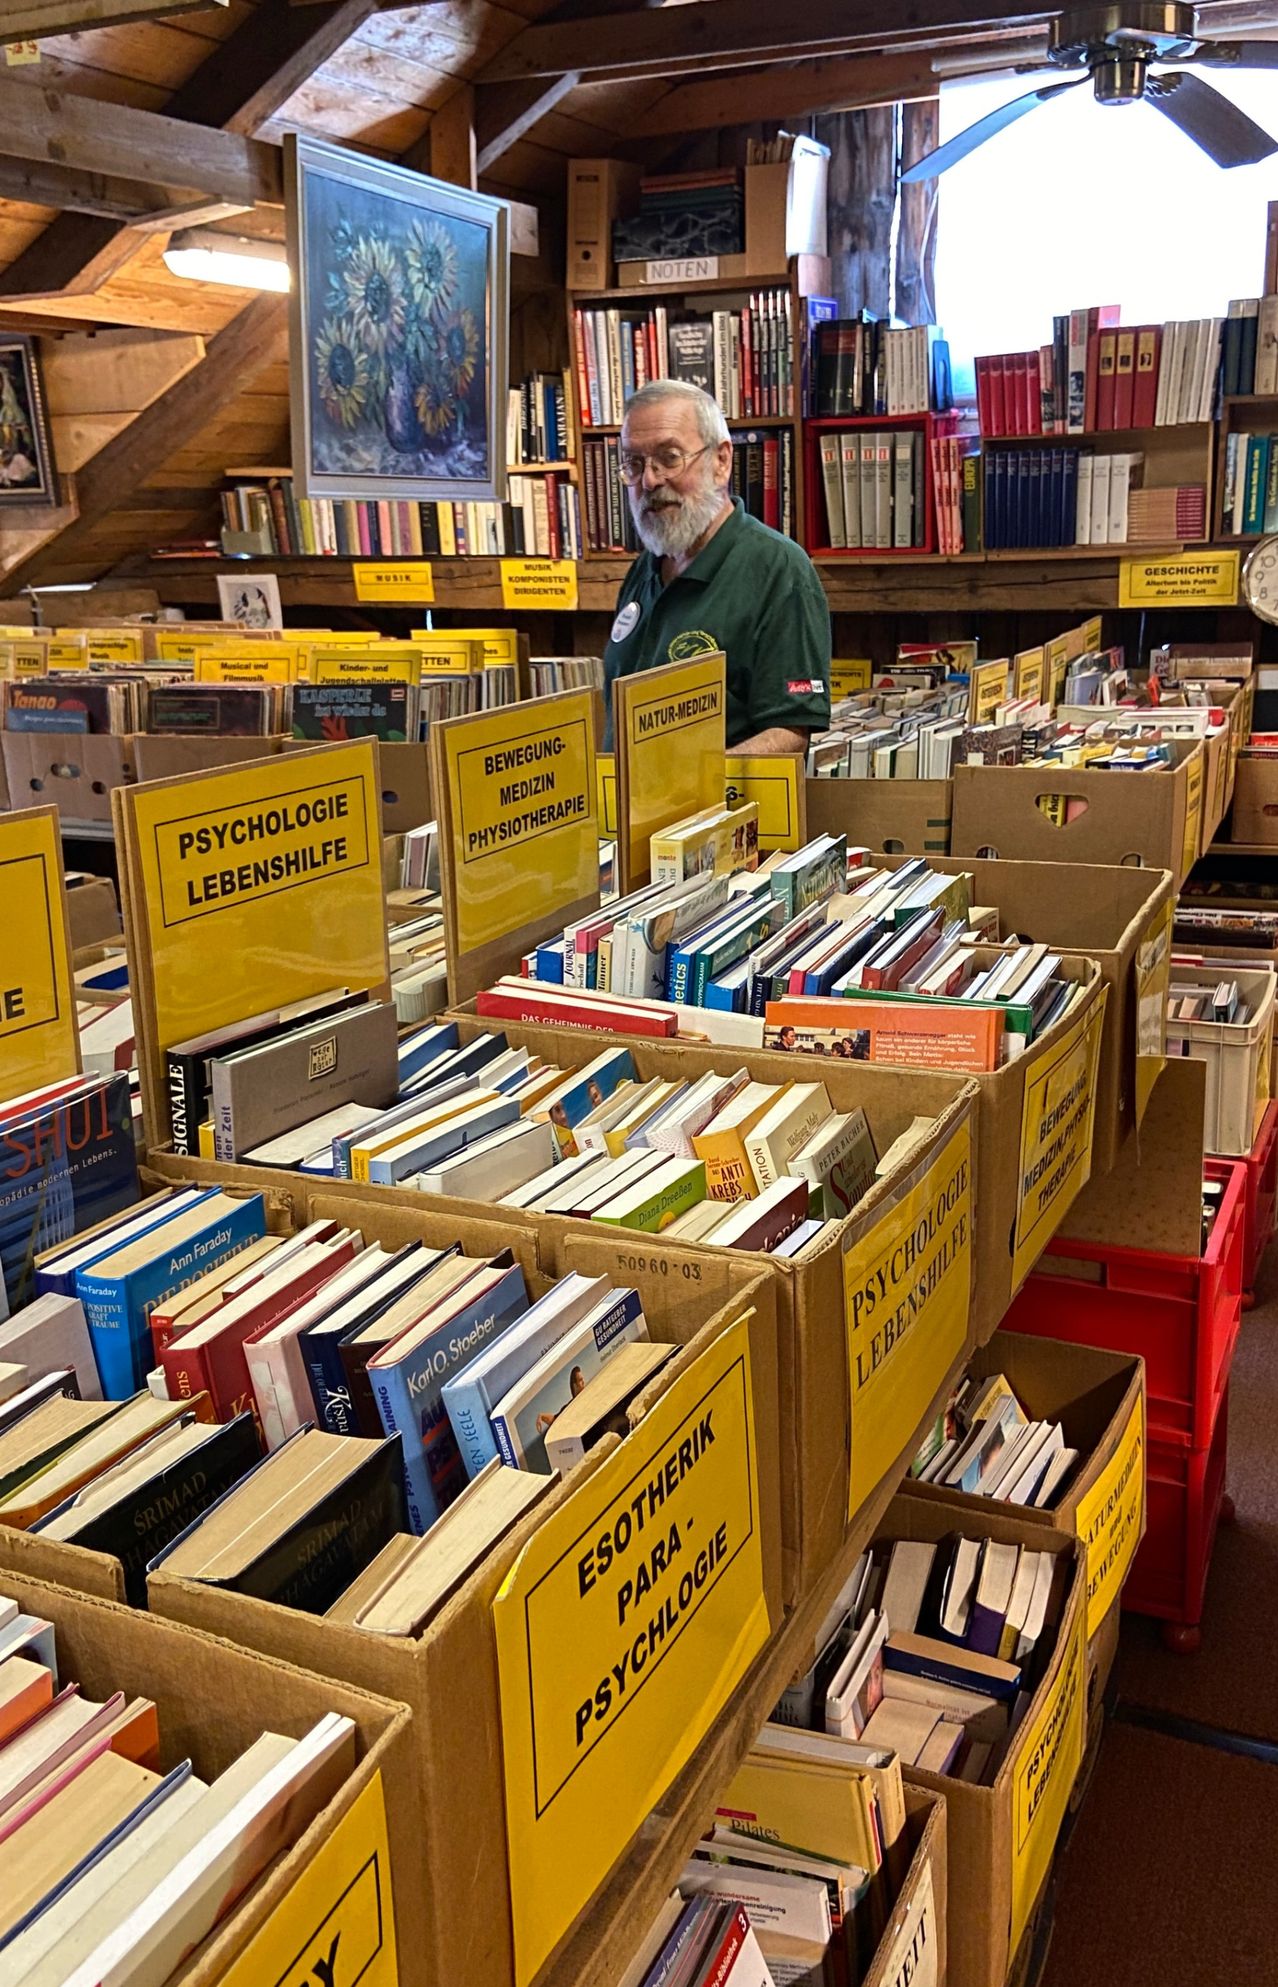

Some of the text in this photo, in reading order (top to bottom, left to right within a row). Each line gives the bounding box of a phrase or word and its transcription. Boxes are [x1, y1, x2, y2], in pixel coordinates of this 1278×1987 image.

[650, 259, 709, 281] NOTEN
[719, 343, 728, 391] Jahrhundert
[556, 397, 568, 446] KARAJAN
[508, 575, 570, 584] KOMPONISTEN
[524, 563, 551, 571] MUSIK
[1145, 565, 1219, 576] GESCHICHTE
[1255, 570, 1265, 583] 9
[1260, 555, 1277, 569] 10
[514, 587, 566, 596] DIRIGENTEN
[1259, 586, 1268, 600] 8
[221, 662, 269, 671] Musical und
[339, 663, 389, 672] Kinder- und
[12, 689, 56, 711] Tango
[638, 691, 718, 733] NATUR-MEDIZIN
[484, 736, 567, 776] BEWEGUNG-
[499, 771, 555, 806] MEDIZIN
[178, 793, 349, 860] PSYCHOLOGIE
[468, 794, 585, 853] PHYSIOTHERAPIE
[187, 836, 348, 907] LEBENSHILFE
[564, 938, 576, 980] JOURNAL
[521, 1013, 540, 1025] DAS
[169, 1063, 188, 1157] SIGNALE
[1039, 1069, 1087, 1145] BEWEGUNG
[3, 1083, 114, 1178] SHUI
[222, 1105, 233, 1160] der Zeit
[819, 1121, 865, 1171] PETER BACHER
[37, 1163, 80, 1190] modernen
[82, 1148, 118, 1169] Lebens.
[721, 1163, 745, 1181] ANTI
[710, 1179, 742, 1200] KREBS
[638, 1204, 660, 1227] Diana
[168, 1227, 232, 1275] Ann Faraday
[852, 1159, 968, 1332] PSYCHOLOGIE
[76, 1281, 118, 1298] Ann Faraday
[856, 1213, 967, 1392] LEBENSHILFE
[87, 1303, 123, 1314] POSITIVE
[601, 1303, 627, 1330] RATGEBER
[597, 1314, 627, 1347] GESUNDHEIT
[406, 1312, 496, 1399] Karl O. Stoeber
[457, 1408, 479, 1443] SEELE
[577, 1409, 717, 1600] ESOTHERIK
[1086, 1435, 1142, 1547] ATURMEDIZIN
[1109, 1503, 1123, 1540] und
[616, 1526, 683, 1627] PARA
[574, 1520, 729, 1748] PSYCHLOGIE
[730, 1818, 780, 1841] Pilates
[738, 1912, 747, 1933] 3
